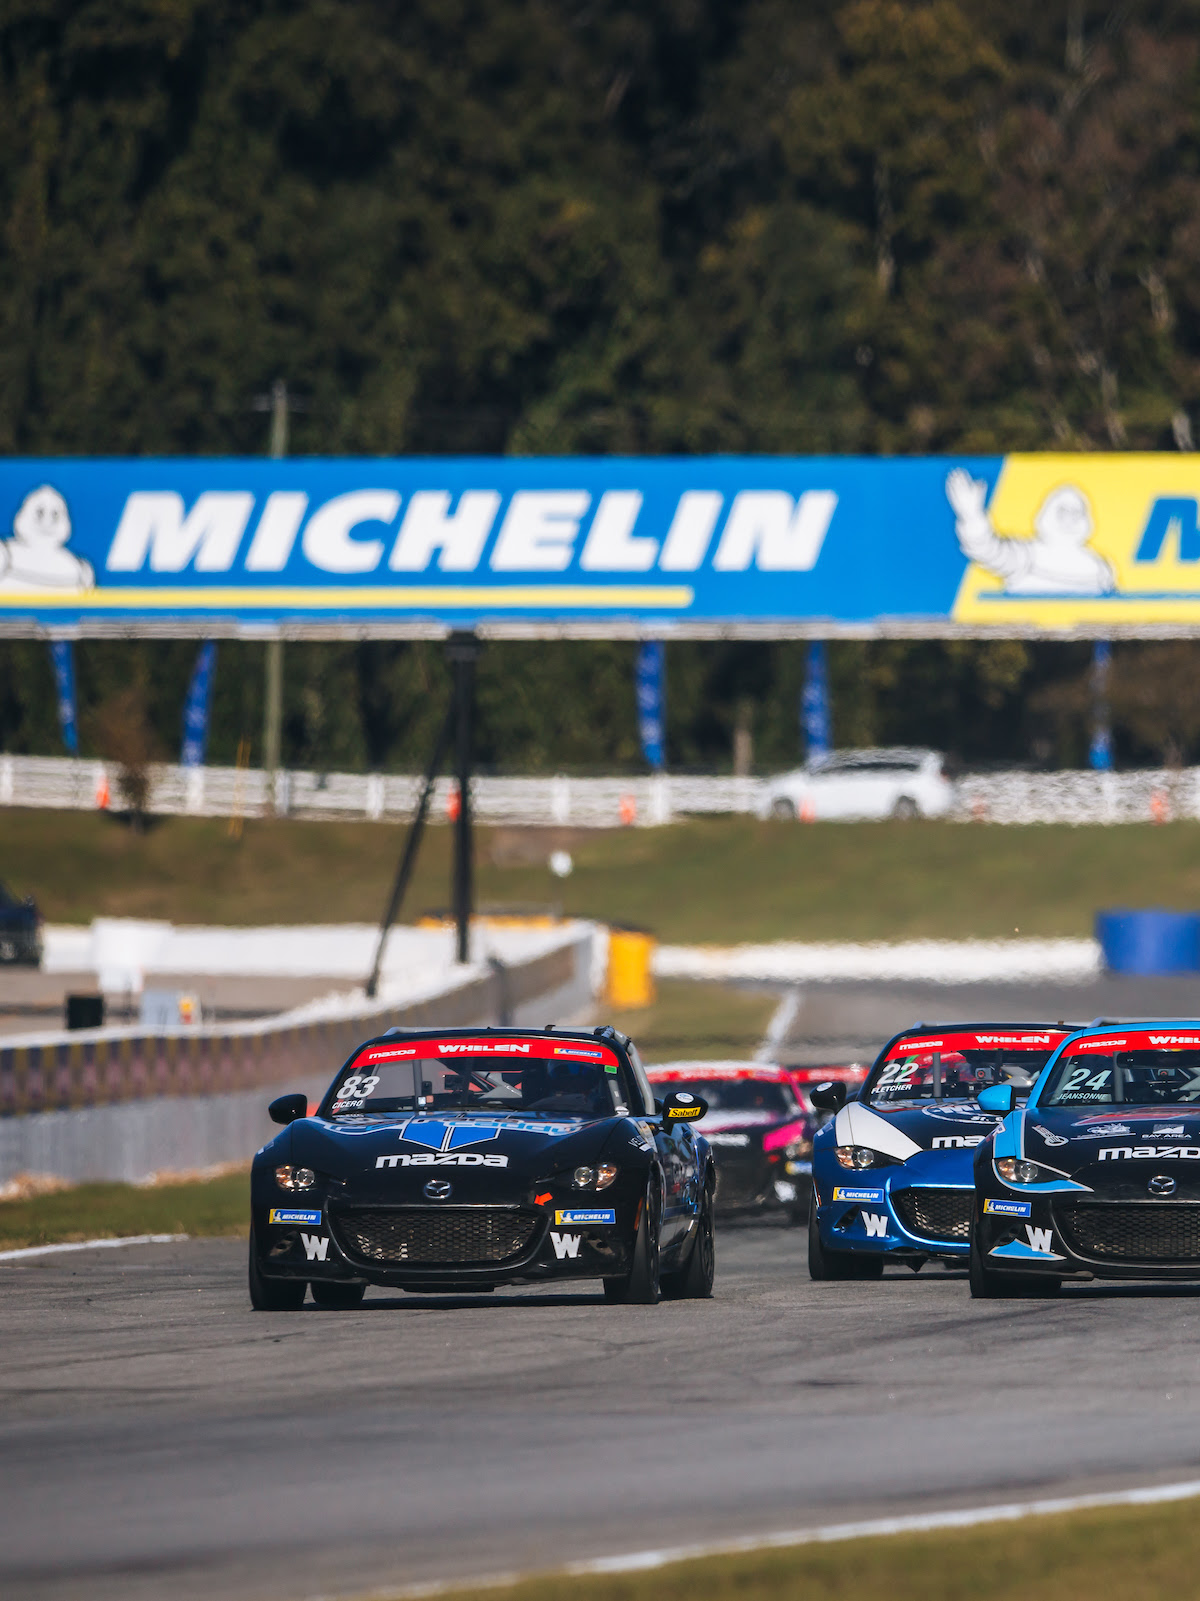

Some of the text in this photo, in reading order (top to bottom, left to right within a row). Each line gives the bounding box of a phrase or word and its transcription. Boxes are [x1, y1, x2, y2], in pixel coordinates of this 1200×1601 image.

[106, 488, 838, 573] MICHELIN
[975, 1035, 1050, 1044] WHELEN
[438, 1044, 531, 1053] WHELEN
[876, 1063, 919, 1085] 22
[1062, 1068, 1112, 1091] 24
[336, 1076, 380, 1099] 83
[871, 1084, 913, 1094] FLETCHER
[1056, 1093, 1109, 1101] JEANSONNE
[331, 1100, 364, 1109] CICERO
[846, 1191, 879, 1199] MICHELIN
[995, 1204, 1027, 1213] MICHELIN
[282, 1213, 317, 1221] MICHELIN
[572, 1213, 612, 1221] MICHELIN
[861, 1210, 889, 1238] W
[1025, 1224, 1054, 1253] W
[300, 1232, 330, 1261] W
[549, 1231, 582, 1260] W
